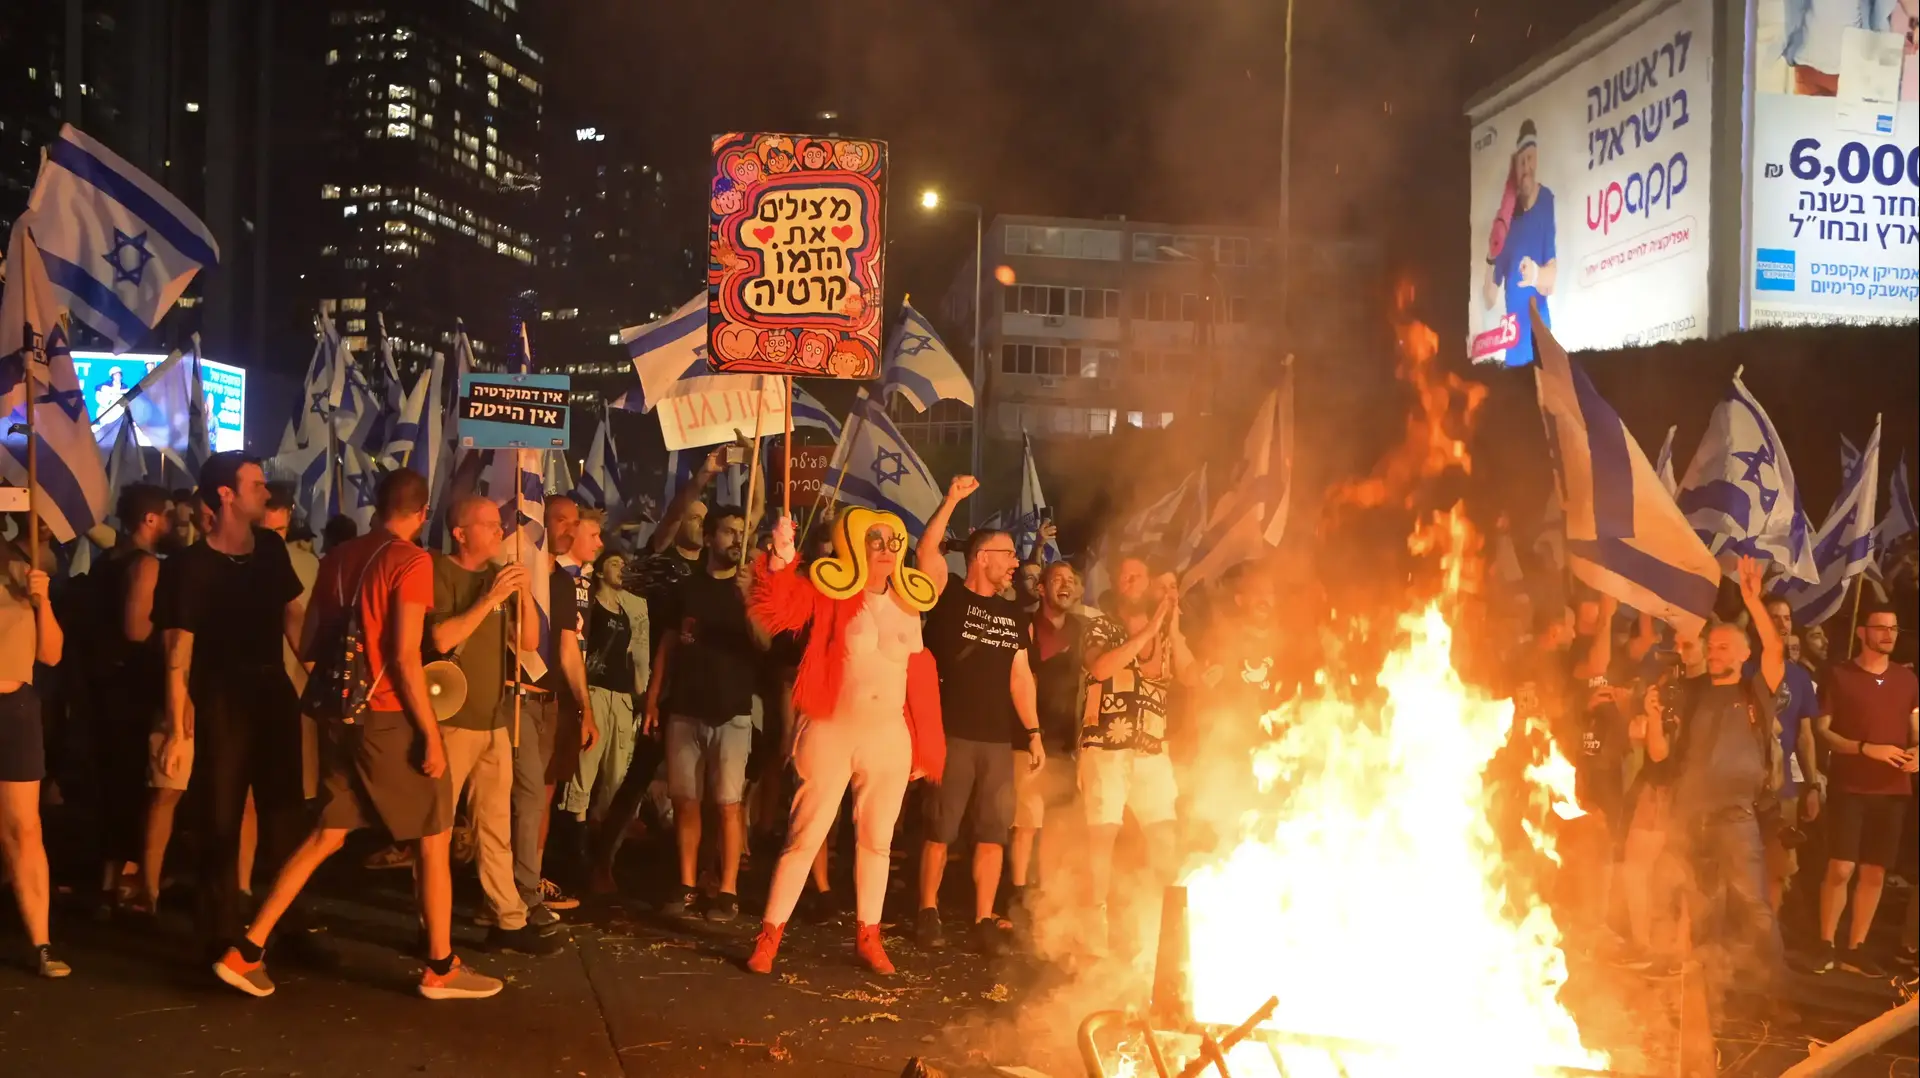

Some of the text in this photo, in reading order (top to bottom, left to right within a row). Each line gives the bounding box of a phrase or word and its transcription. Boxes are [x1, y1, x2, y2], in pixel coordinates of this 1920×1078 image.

[1587, 30, 1692, 124] לראשונה
[1588, 89, 1689, 170] בישראל!
[1764, 163, 1784, 178] ₪
[1586, 151, 1688, 235] upapp
[1798, 191, 1919, 217] חזר בשנה
[760, 192, 851, 222] מצילים
[782, 225, 826, 245] את
[1757, 262, 1794, 271] AMERICAN
[1810, 262, 1869, 281] אקספרס
[754, 275, 847, 311] קרטיה
[1810, 279, 1919, 302] קאשבק פרימיום
[1500, 314, 1517, 344] 25
[474, 385, 563, 403] אין דמוקרטיה
[469, 402, 558, 425] אין הייטק
